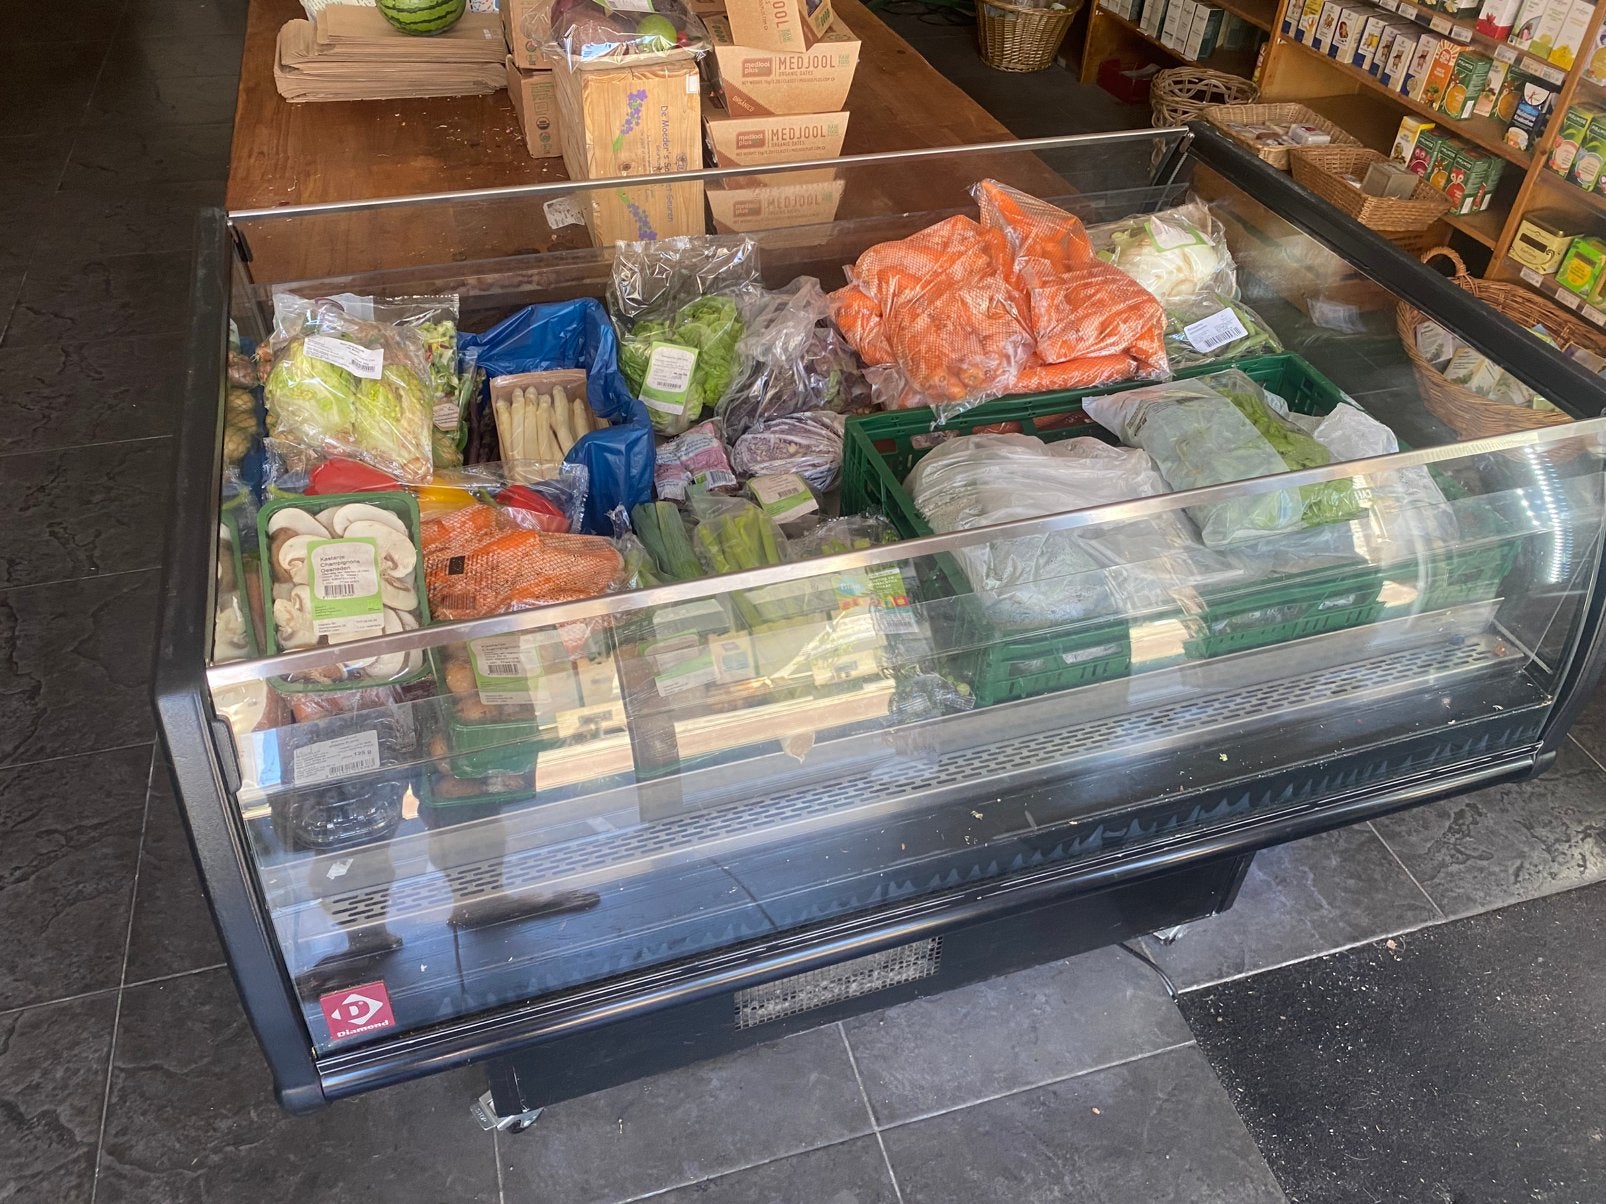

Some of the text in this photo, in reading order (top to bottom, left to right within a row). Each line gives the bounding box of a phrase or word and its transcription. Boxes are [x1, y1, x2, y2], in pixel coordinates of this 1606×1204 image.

[778, 55, 836, 71] MEDJOOL
[770, 125, 826, 142] MEDJOOL
[337, 1020, 389, 1037] Diamond
